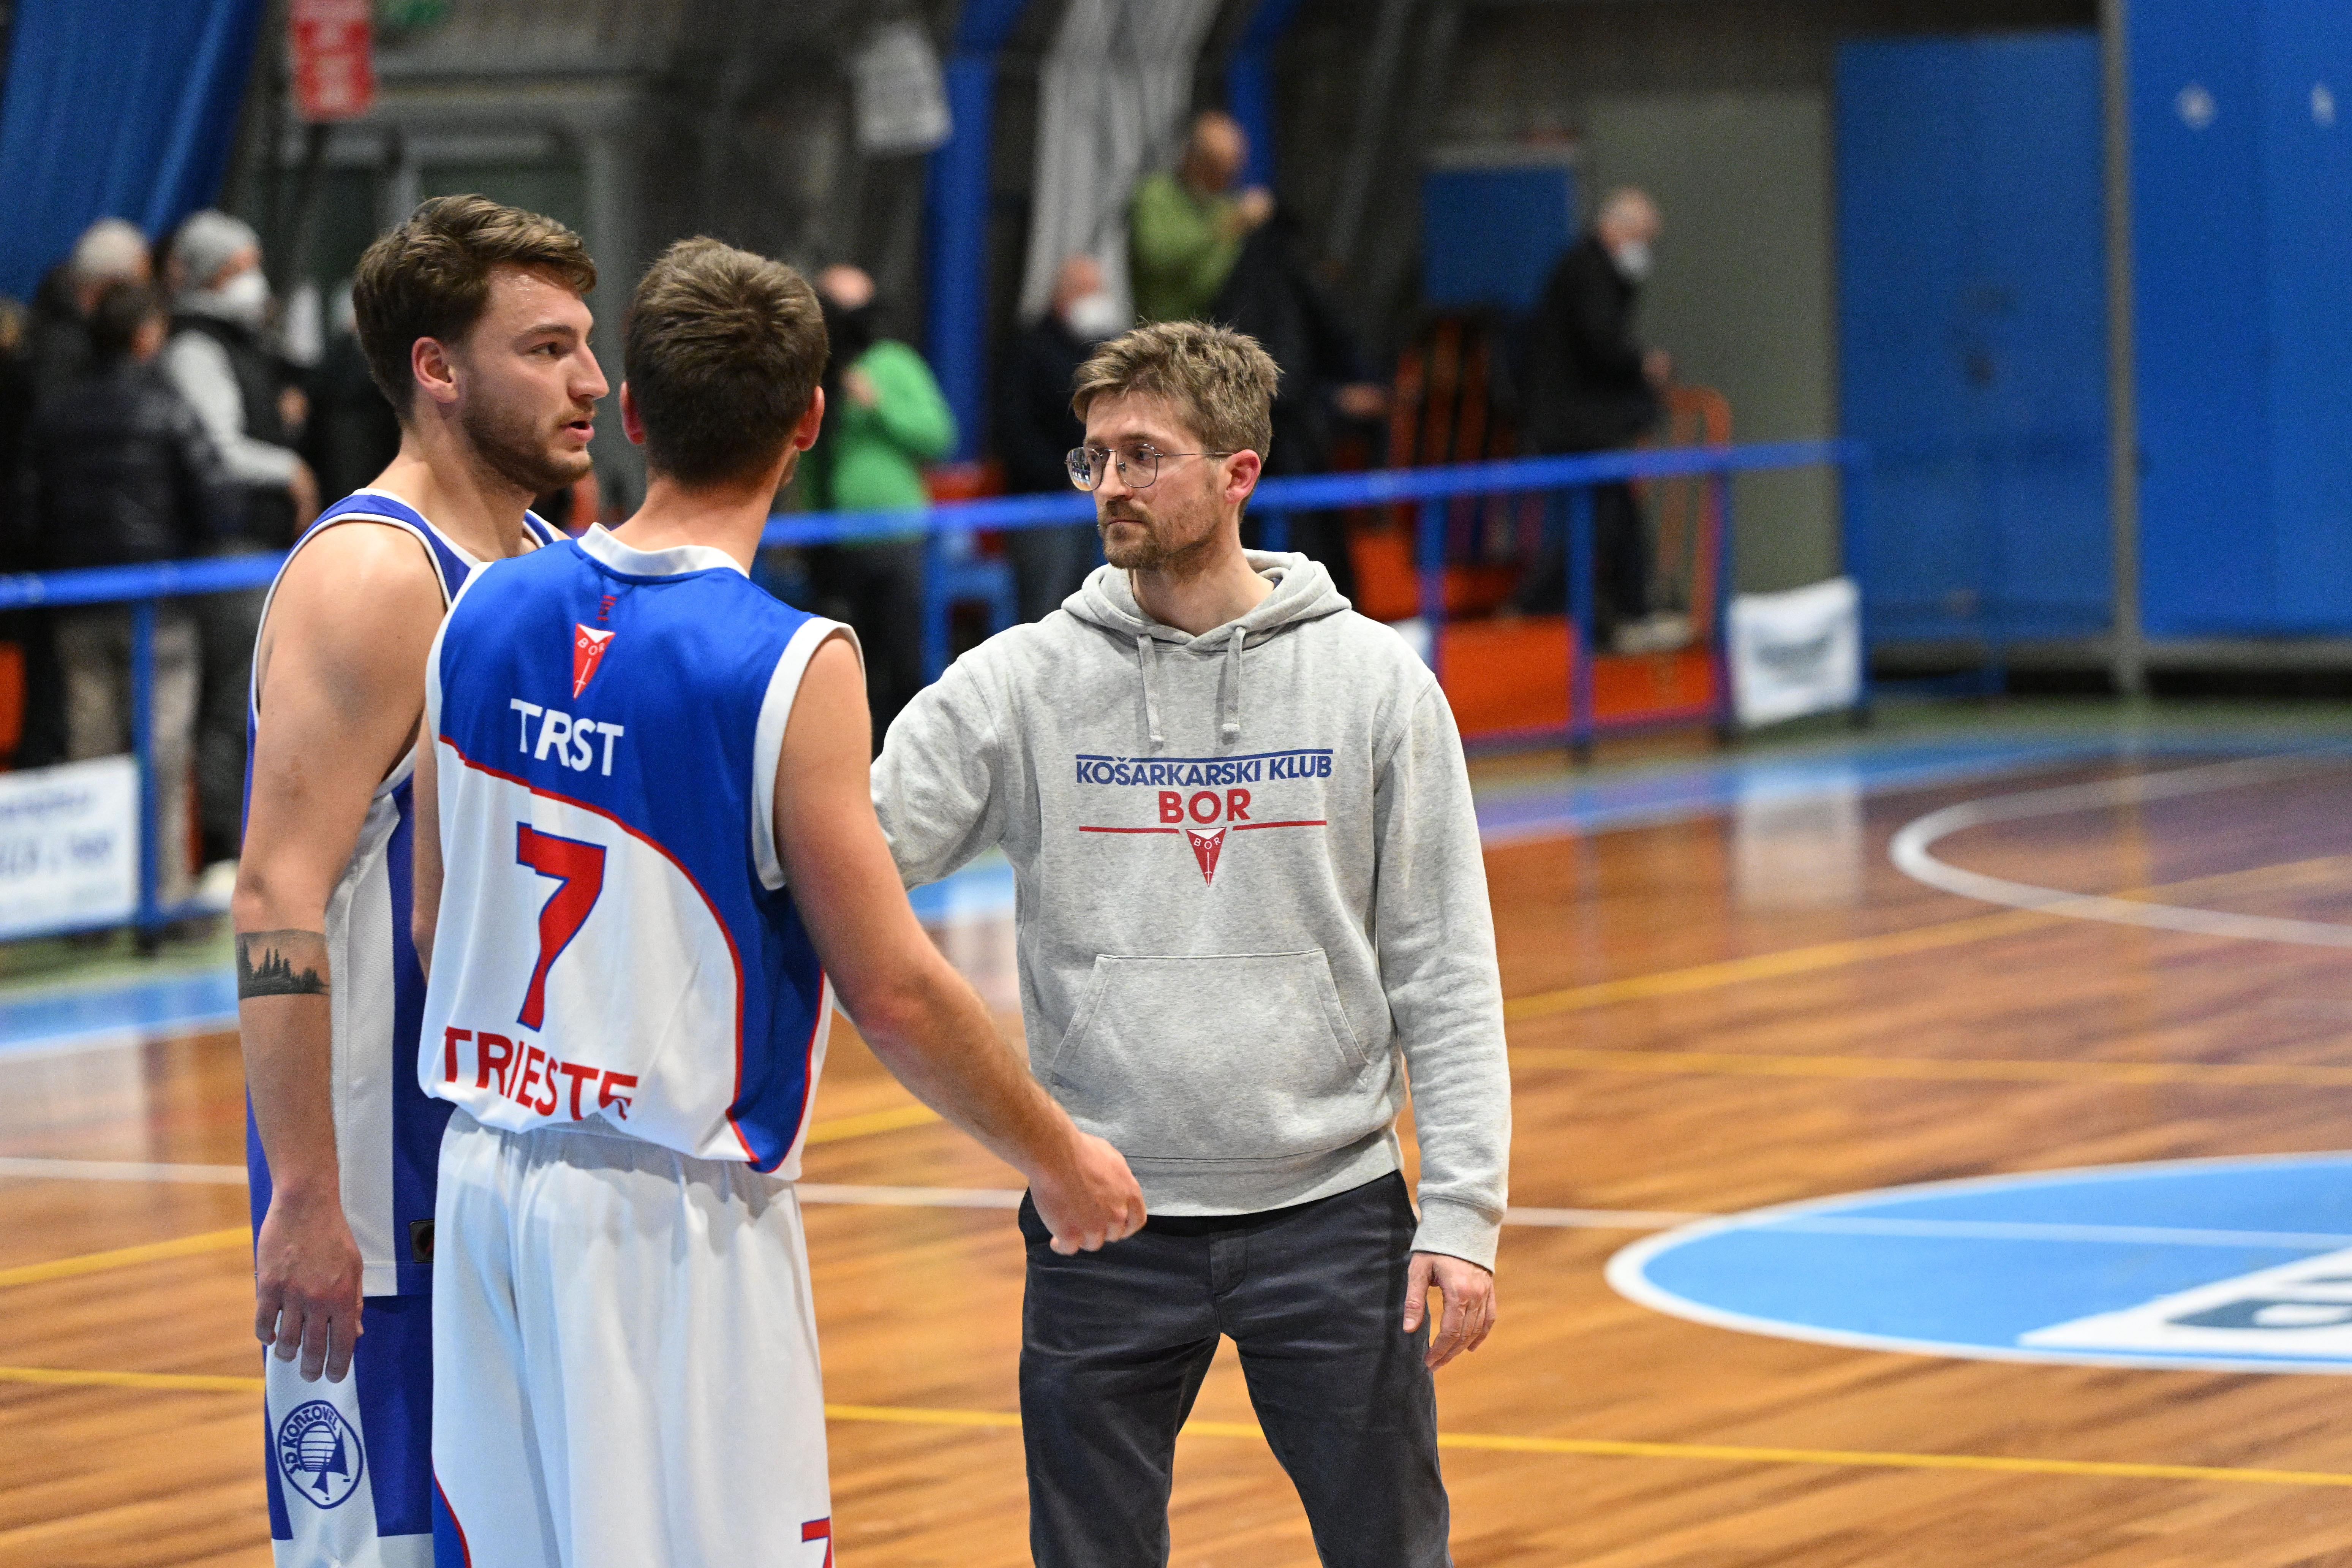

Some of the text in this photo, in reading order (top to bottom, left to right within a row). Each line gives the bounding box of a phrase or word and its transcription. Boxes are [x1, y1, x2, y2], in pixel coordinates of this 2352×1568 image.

[577, 637, 605, 656] BOR
[510, 698, 625, 777] TRST
[1076, 756, 1332, 786] KOŠARKARSKI KLUB
[1158, 788, 1251, 824] BOR
[1193, 837, 1221, 850] BOR
[515, 822, 607, 1032] 7
[444, 1026, 639, 1121] TRIESTE
